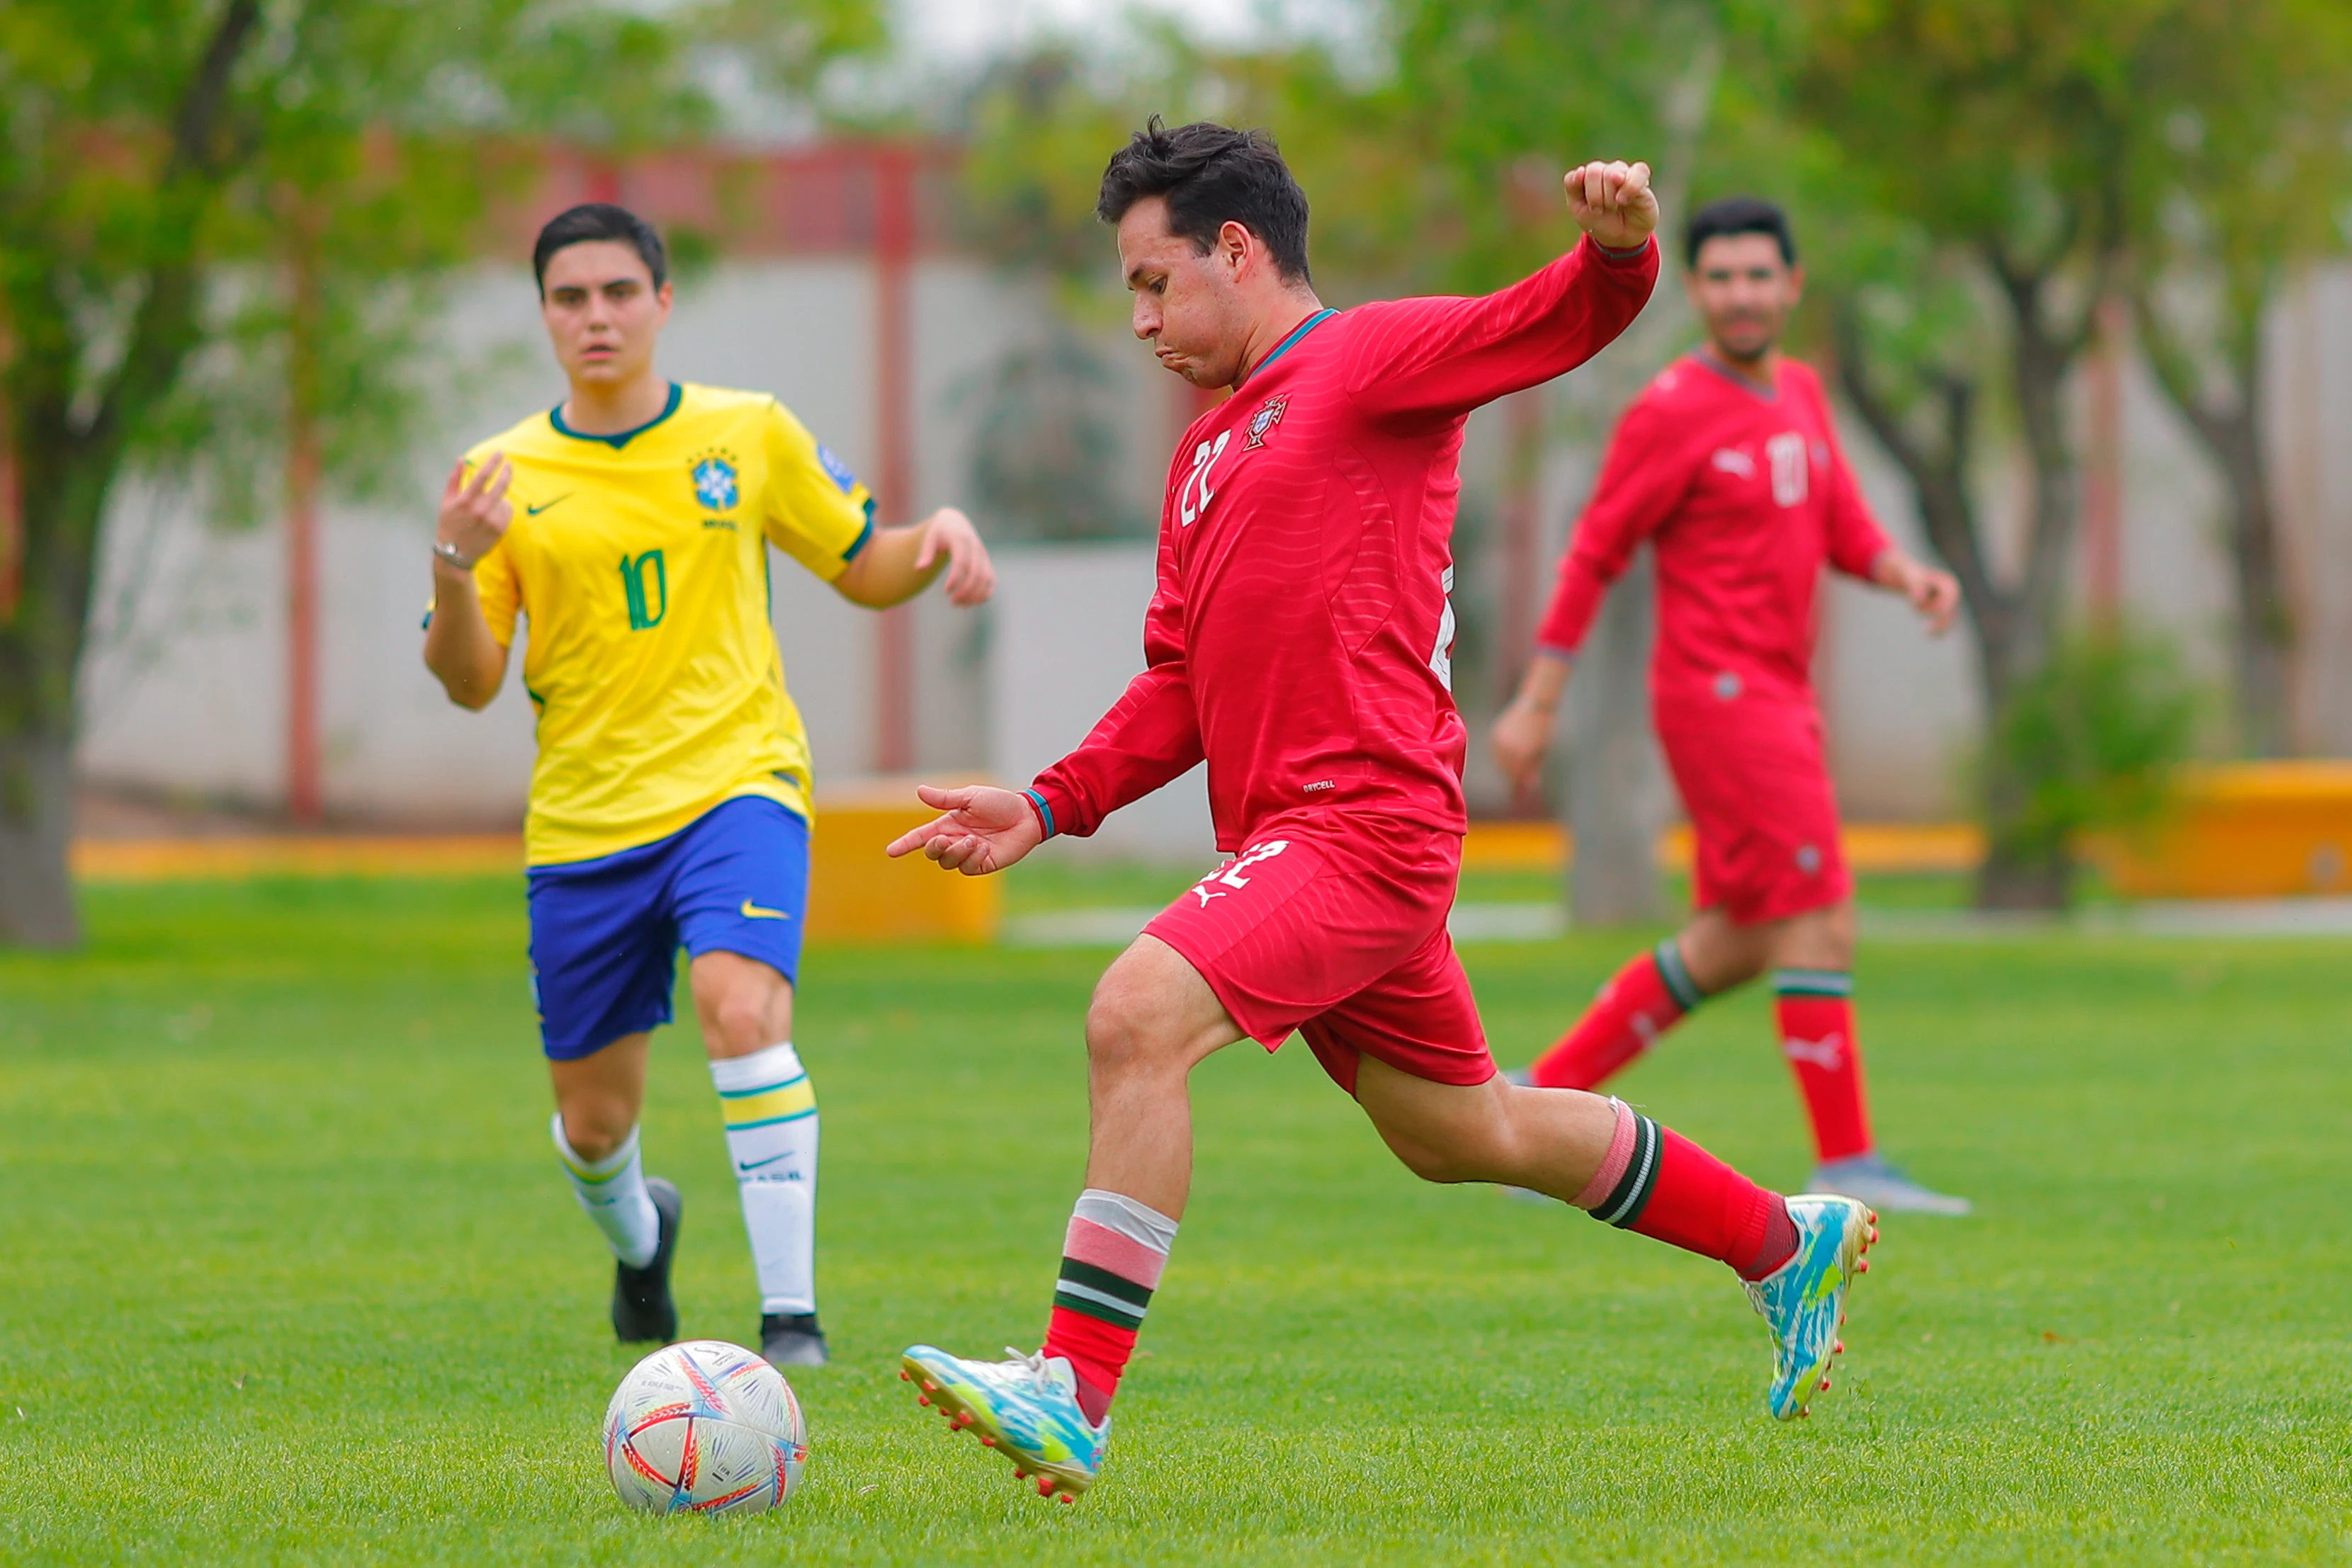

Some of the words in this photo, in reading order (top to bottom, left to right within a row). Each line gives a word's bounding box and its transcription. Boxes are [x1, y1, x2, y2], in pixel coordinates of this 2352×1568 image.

[1181, 428, 1232, 528] 22
[619, 549, 666, 630] 10
[1303, 780, 1336, 793] DRYCELL
